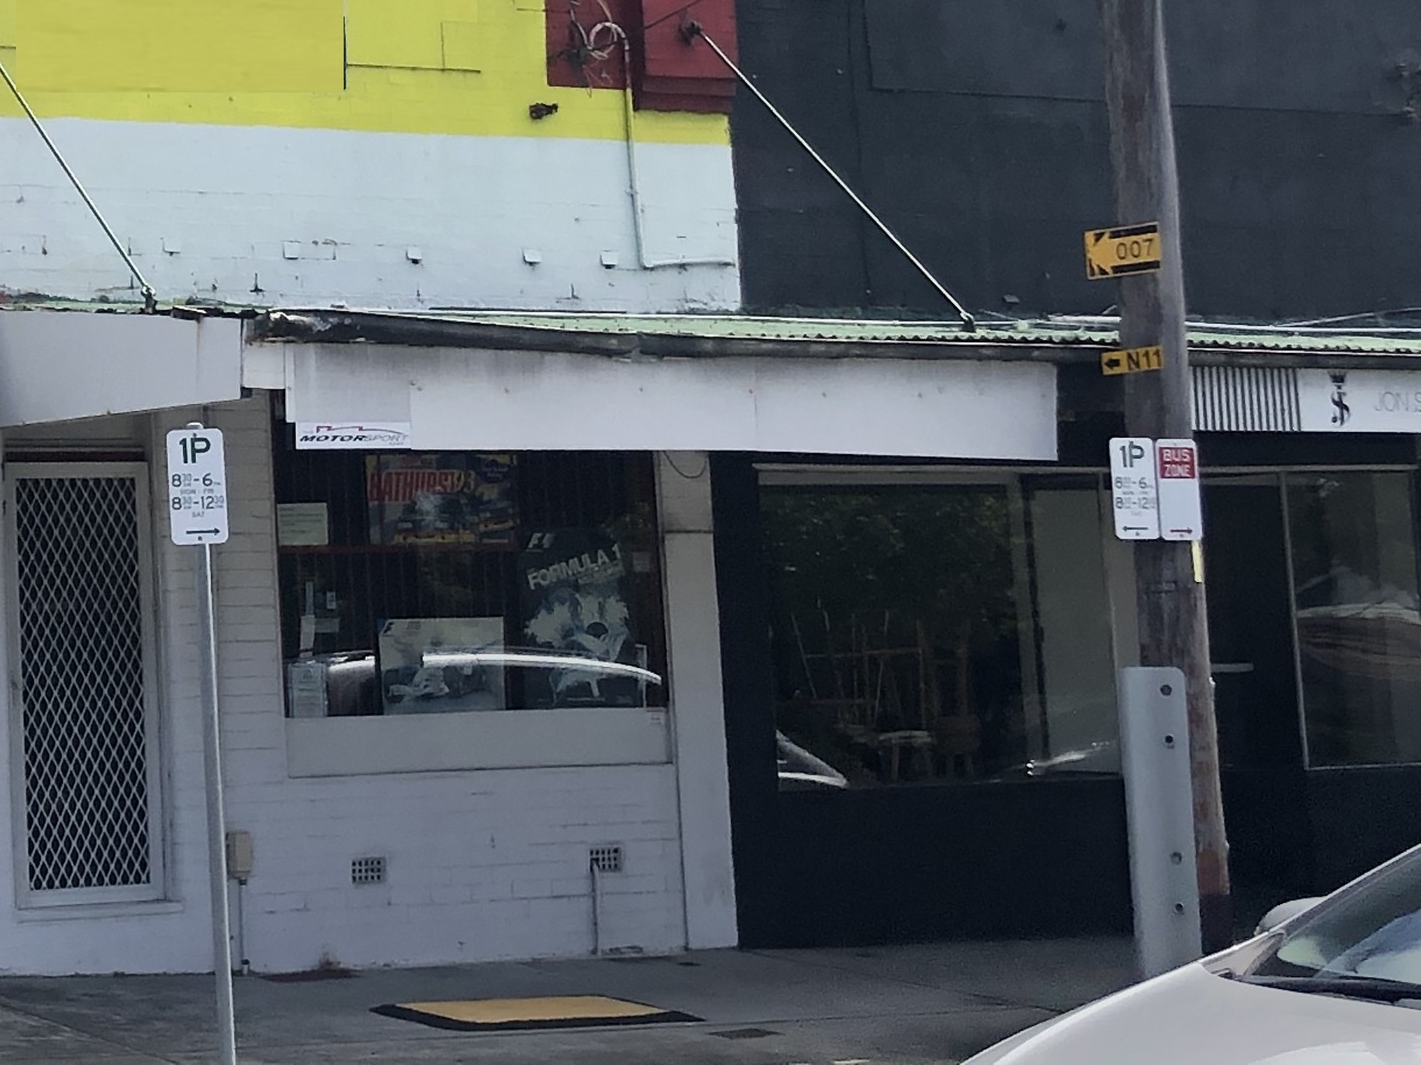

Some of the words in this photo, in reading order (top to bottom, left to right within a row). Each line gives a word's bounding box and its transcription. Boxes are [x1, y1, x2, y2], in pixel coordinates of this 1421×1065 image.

[1116, 238, 1154, 261] 007
[1126, 349, 1163, 370] N11
[299, 434, 409, 442] MOTORSPORT
[179, 437, 211, 463] 1P
[1119, 444, 1145, 468] 1P
[1163, 449, 1191, 462] BUS
[1164, 464, 1192, 477] ZONE
[527, 548, 610, 590] FORMULA
